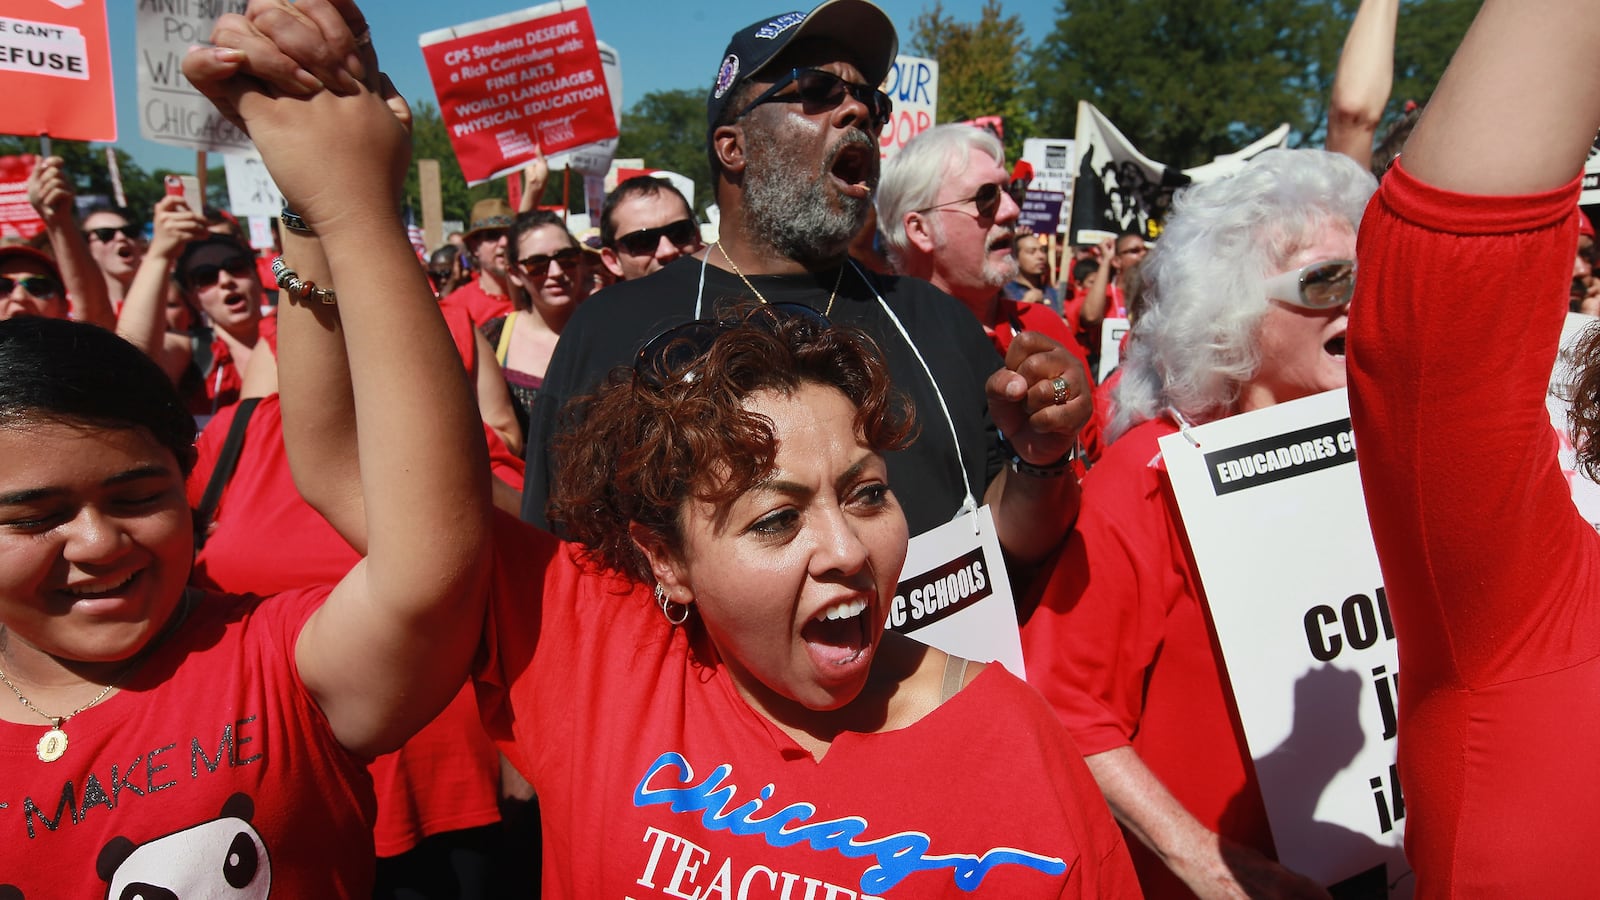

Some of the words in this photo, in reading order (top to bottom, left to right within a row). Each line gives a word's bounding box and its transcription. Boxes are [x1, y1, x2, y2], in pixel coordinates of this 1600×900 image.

[13, 23, 64, 40] CAN'T
[444, 48, 471, 66] CPS
[472, 40, 524, 59] Students
[525, 20, 579, 45] DESERVE
[0, 45, 83, 73] EFUSE
[450, 73, 459, 83] a
[461, 62, 488, 80] Rich
[491, 48, 554, 71] Curriculum
[556, 38, 584, 54] with:
[486, 72, 517, 91] FINE
[521, 63, 555, 82] ARTS
[454, 108, 522, 137] PHYSICAL
[524, 85, 604, 116] EDUCATION
[455, 93, 509, 117] WORLD
[512, 69, 595, 101] LANGUAGES
[1216, 435, 1337, 484] EDUCADORES
[909, 560, 986, 620] SCHOOLS
[24, 743, 177, 839] MAKE
[191, 715, 263, 779] ME
[633, 751, 1067, 895] Chicago
